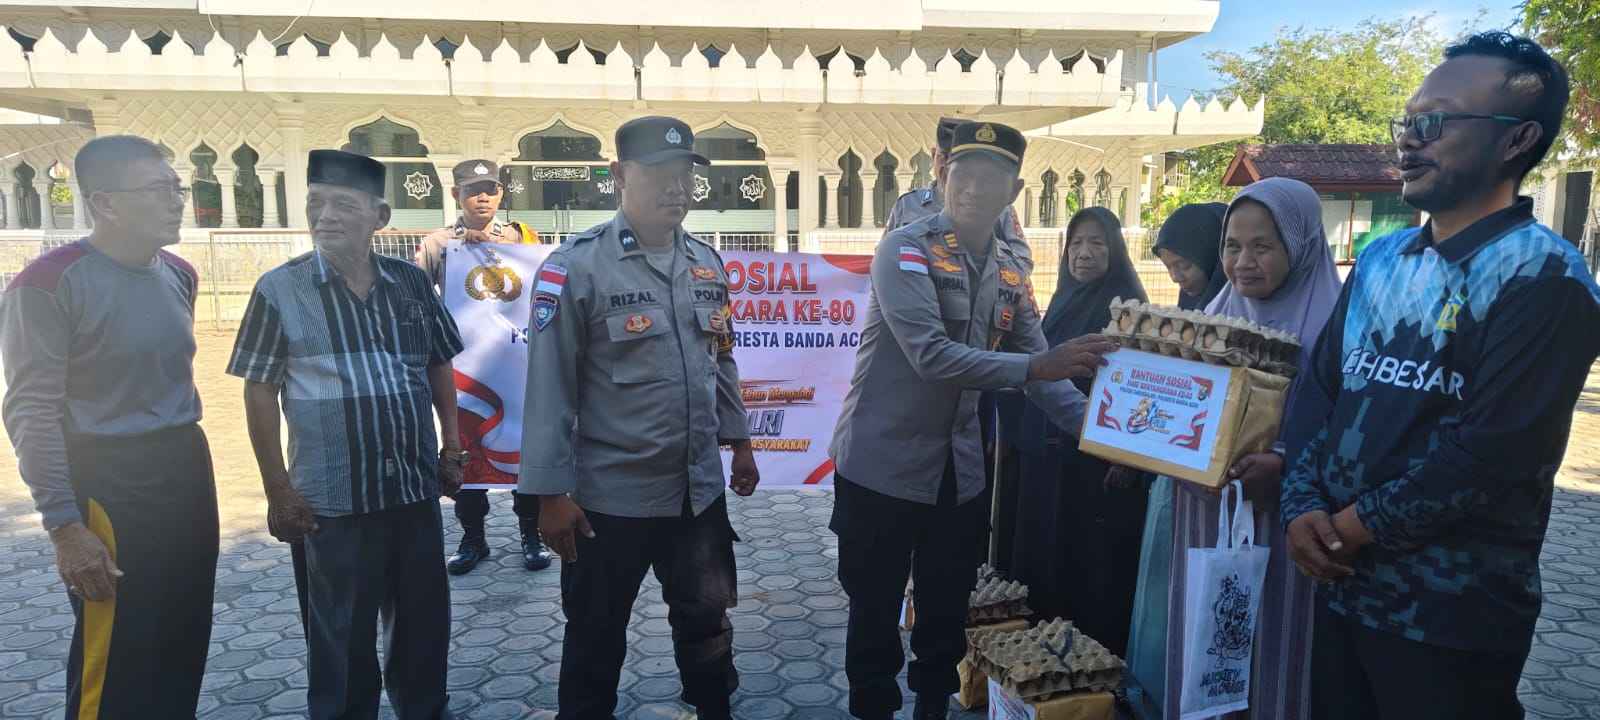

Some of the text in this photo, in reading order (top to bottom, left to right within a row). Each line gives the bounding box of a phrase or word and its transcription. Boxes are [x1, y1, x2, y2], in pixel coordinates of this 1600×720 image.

[610, 291, 656, 307] RIZAL
[794, 299, 856, 324] KE-80
[784, 332, 834, 348] BANDA
